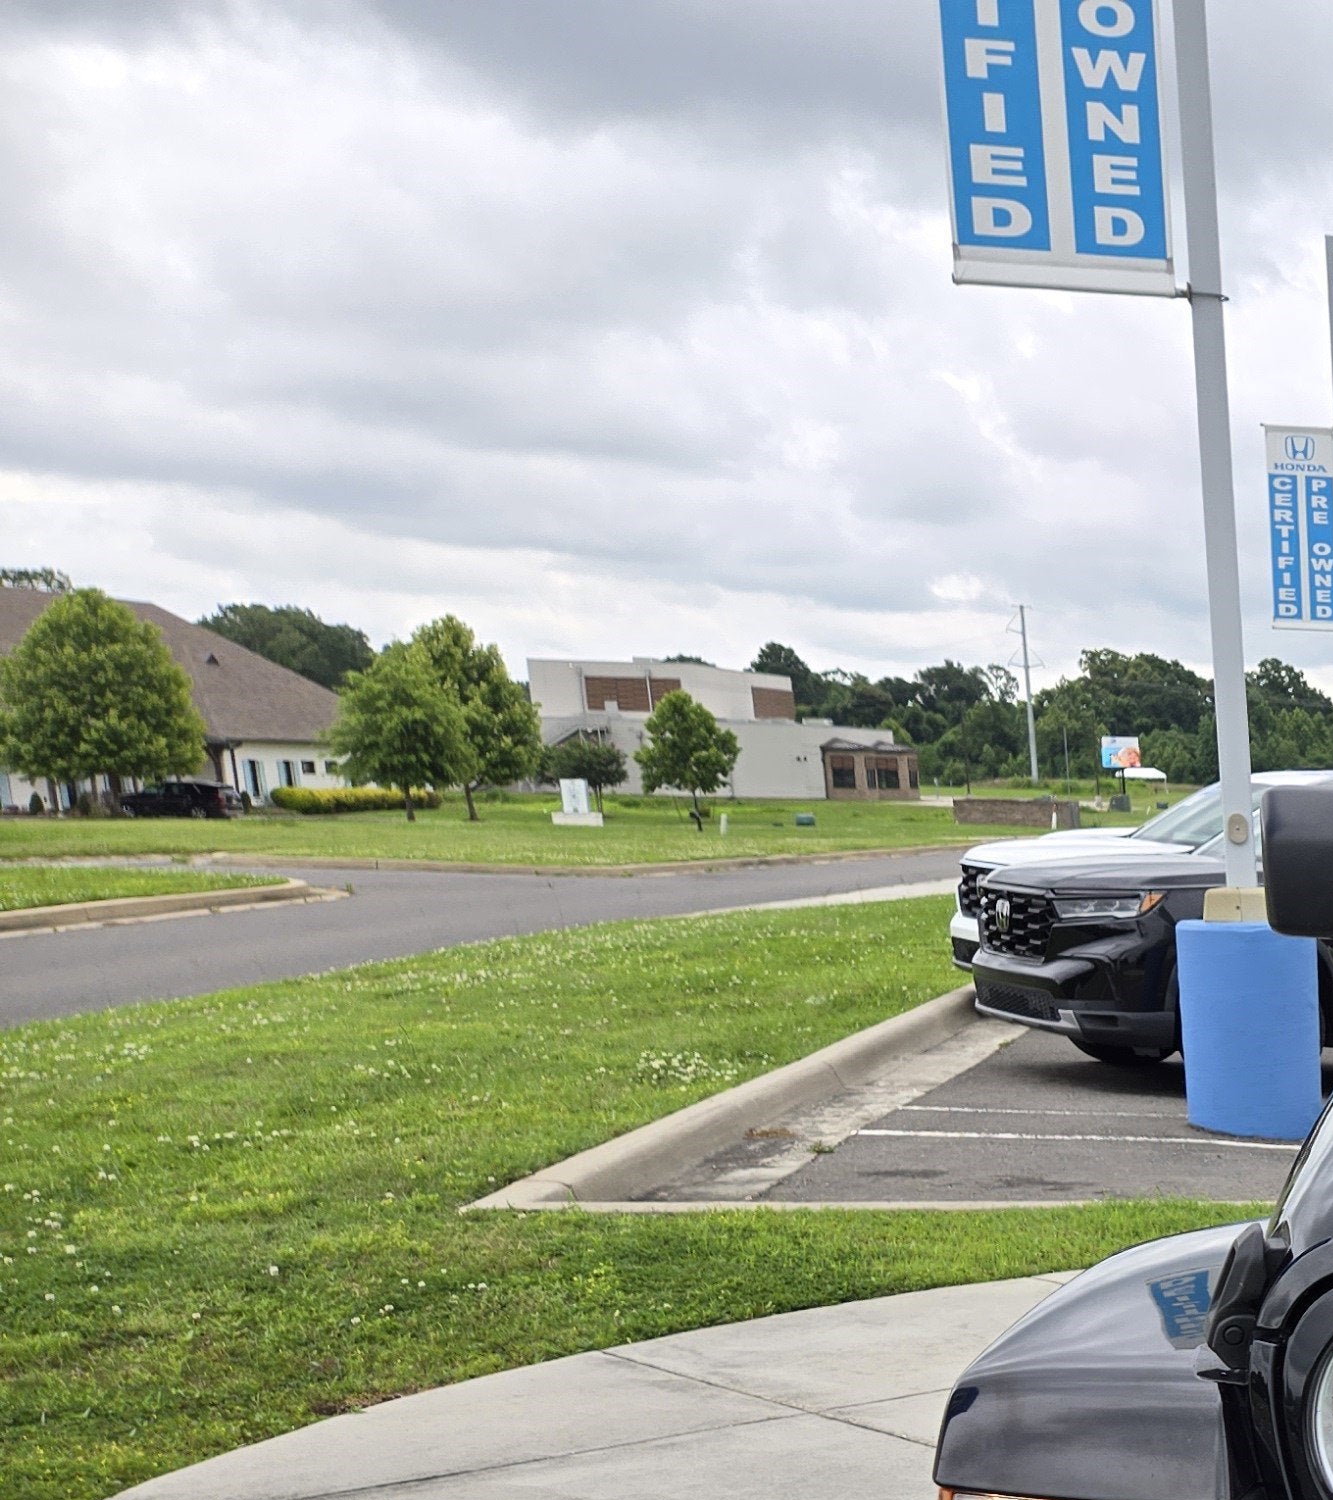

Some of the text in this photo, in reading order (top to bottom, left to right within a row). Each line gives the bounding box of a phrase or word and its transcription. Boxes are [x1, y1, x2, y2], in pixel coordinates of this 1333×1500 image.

[1071, 0, 1146, 246] OWNED
[1274, 462, 1328, 473] HONDA
[1272, 476, 1298, 618] CERTIFIED
[1311, 478, 1333, 619] PRE OWNED
